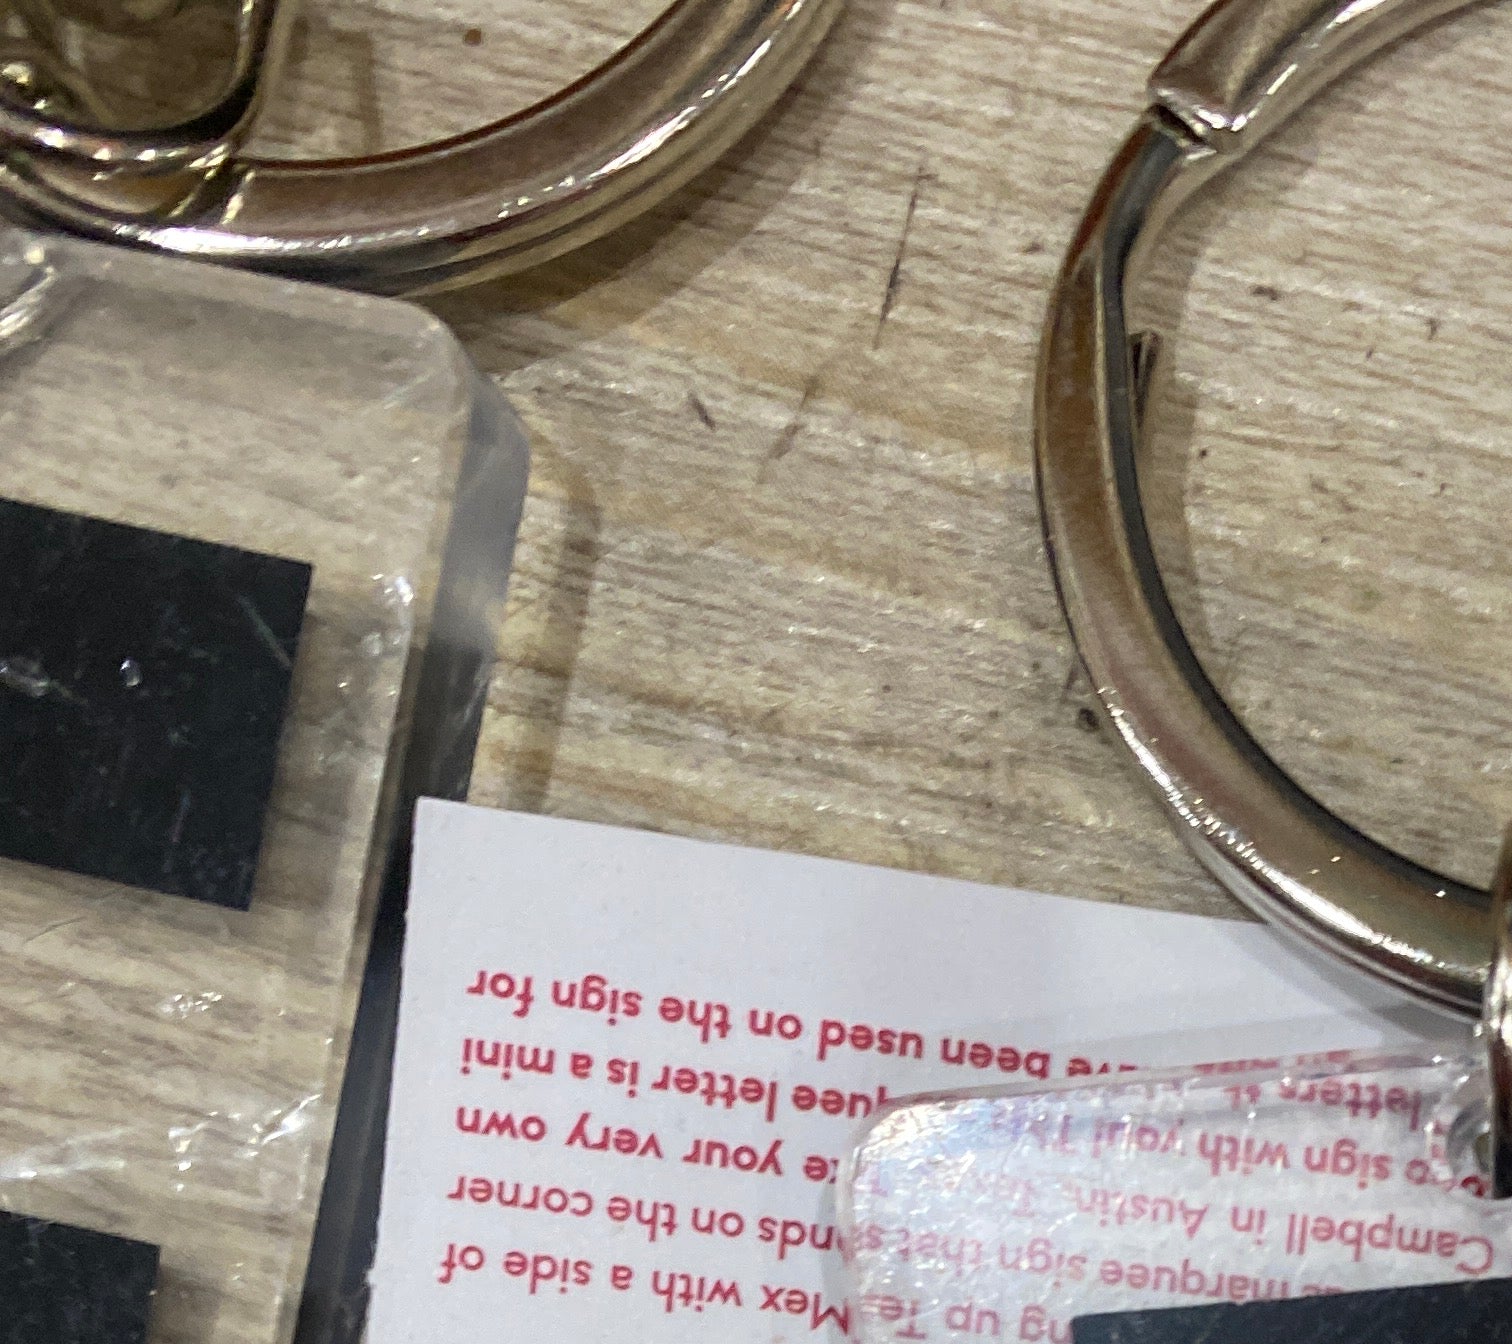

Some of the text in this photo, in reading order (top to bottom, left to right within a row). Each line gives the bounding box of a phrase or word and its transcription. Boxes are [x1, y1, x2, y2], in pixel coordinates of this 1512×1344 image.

[466, 971, 534, 1019] for
[550, 973, 643, 1024] sign
[657, 996, 731, 1044] the
[747, 1008, 803, 1041] on
[816, 1018, 925, 1061] used
[461, 1038, 556, 1080] mini
[568, 1052, 594, 1080] a
[606, 1057, 640, 1098] is
[940, 1039, 1051, 1081] been
[651, 1065, 779, 1122] letter
[455, 1106, 547, 1143] own
[564, 1112, 663, 1158] very
[682, 1139, 783, 1176] your
[1197, 1130, 1291, 1178] with
[1303, 1139, 1394, 1192] sign
[447, 1176, 594, 1217] corner
[606, 1195, 677, 1242] the
[690, 1208, 745, 1238] on
[1230, 1206, 1269, 1247] in
[438, 1243, 485, 1285] of
[999, 1238, 1088, 1292] sign
[1286, 1212, 1496, 1276] Campbell
[502, 1250, 592, 1294] side
[610, 1264, 634, 1291] a
[651, 1270, 742, 1313] with
[1098, 1258, 1291, 1303] marquee
[945, 1297, 1001, 1341] up
